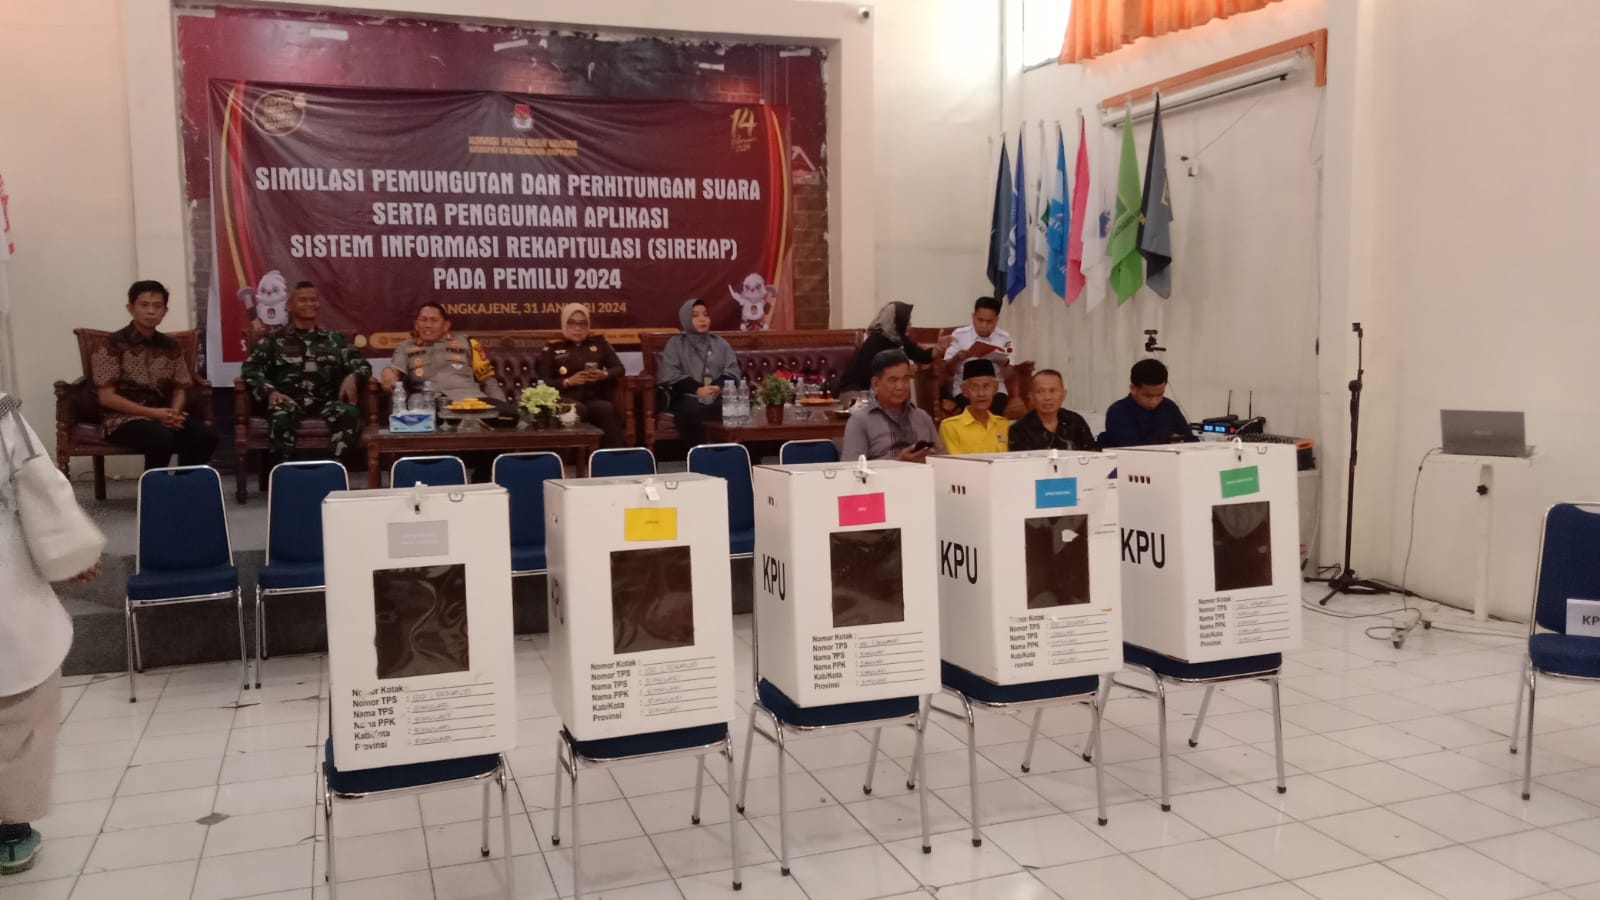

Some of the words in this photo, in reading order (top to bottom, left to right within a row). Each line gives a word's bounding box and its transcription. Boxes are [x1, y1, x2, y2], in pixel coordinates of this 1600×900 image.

[256, 167, 364, 192] SIMULASI
[372, 169, 514, 194] PEMUNGUTAN
[521, 173, 560, 196] DAN
[568, 174, 696, 199] PERHITUNGAN
[702, 178, 761, 200] SUARA
[372, 202, 438, 226] SERTA
[444, 203, 578, 228] PENGGUNAAN
[584, 206, 670, 229] APLIKASI
[290, 234, 374, 258] SISTEM
[381, 235, 499, 258] INFORMASI
[506, 236, 641, 259] REKAPITULASI
[648, 238, 738, 261] (SIREKAP)
[433, 267, 486, 290] PADA
[493, 268, 568, 290] PEMILU
[574, 268, 622, 290] 2024
[523, 303, 539, 314] 31
[599, 302, 627, 313] 2024
[1121, 528, 1166, 569] KPU
[941, 540, 977, 585] KPU
[763, 554, 786, 601] KPU
[616, 670, 631, 678] TPS
[814, 672, 842, 680] Kab/Kota
[381, 685, 403, 694] Kotak
[592, 683, 612, 691] Nama
[613, 680, 628, 688] TPS
[814, 682, 840, 690] Provinsi
[381, 696, 398, 705] TPS
[592, 702, 624, 712] Kab/Kota
[354, 710, 376, 719] Nama
[378, 707, 394, 716] TPS
[593, 713, 622, 721] Provinsi
[378, 718, 395, 727] PPK
[354, 742, 387, 751] Povinsi
